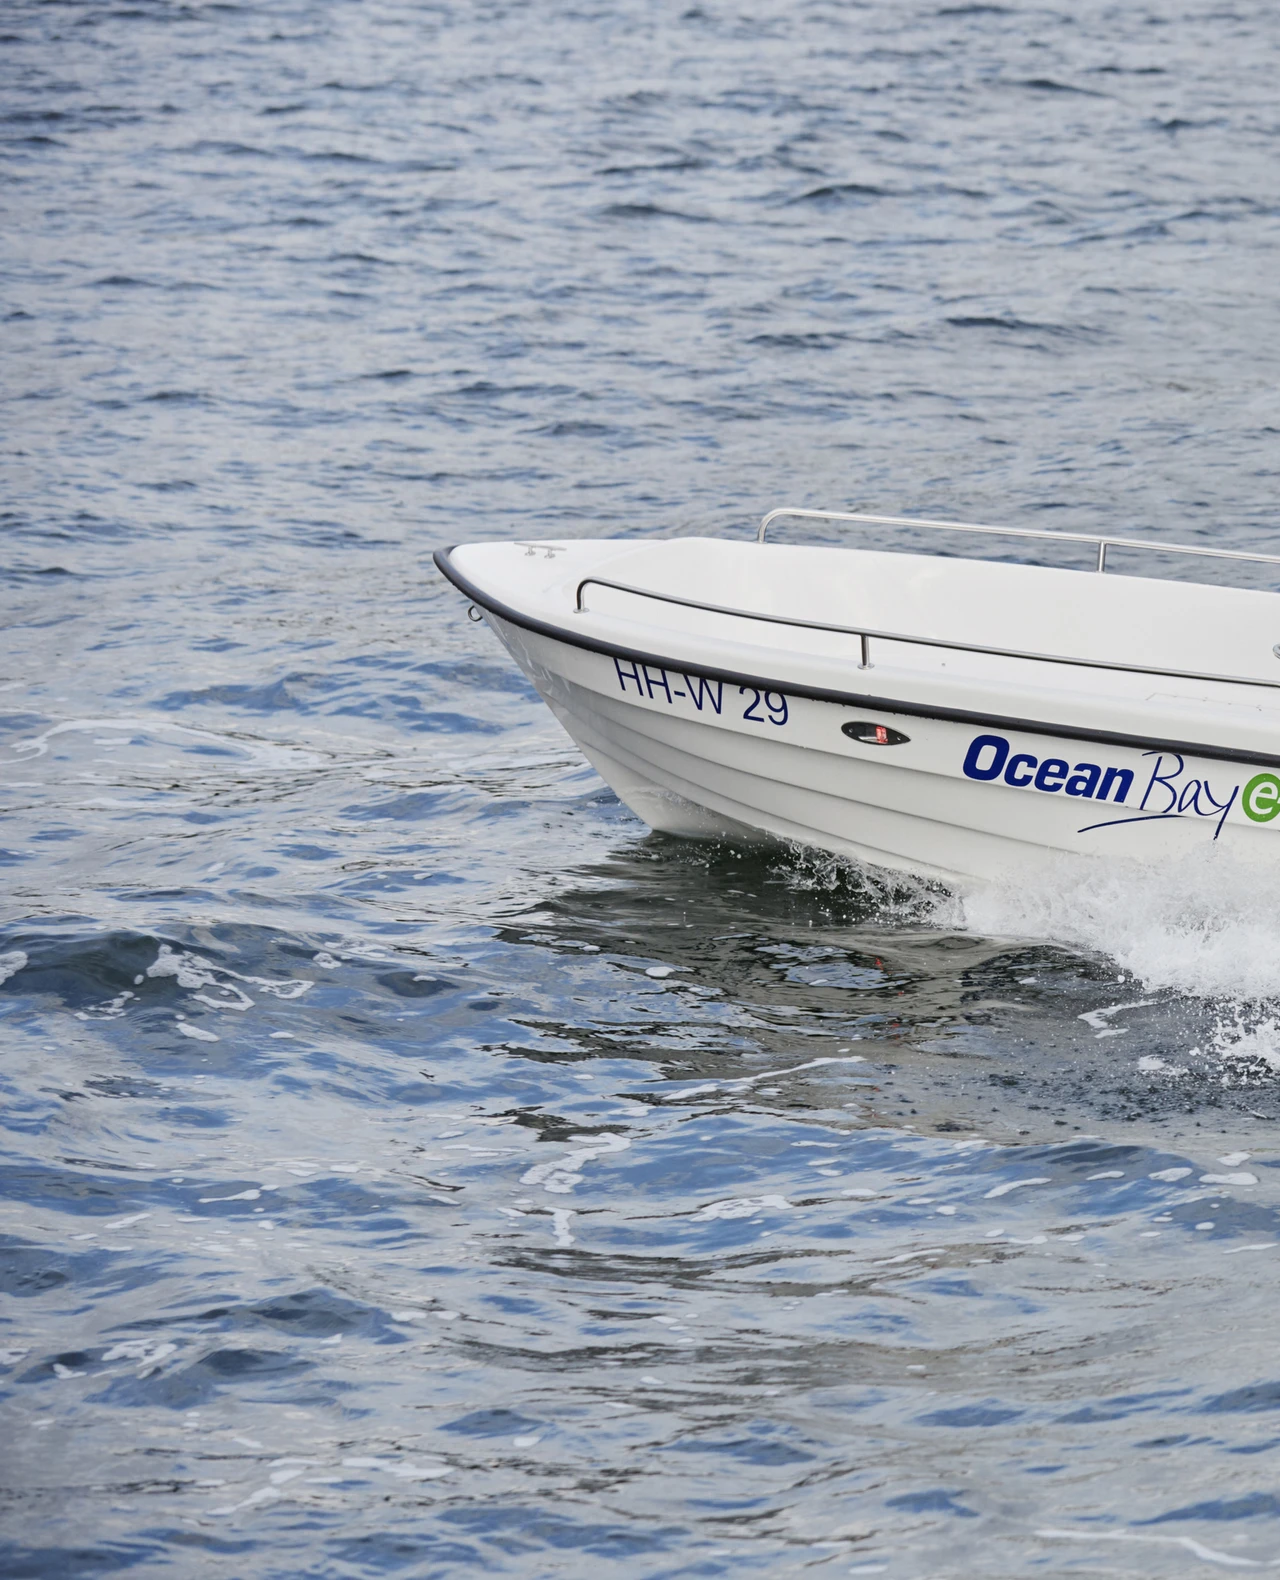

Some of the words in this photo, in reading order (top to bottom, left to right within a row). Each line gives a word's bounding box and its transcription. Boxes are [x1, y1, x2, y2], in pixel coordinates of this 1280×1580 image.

[612, 657, 724, 716] HH-W
[738, 686, 790, 727] 29
[961, 734, 1135, 804] Ocean
[1136, 751, 1240, 840] Bay
